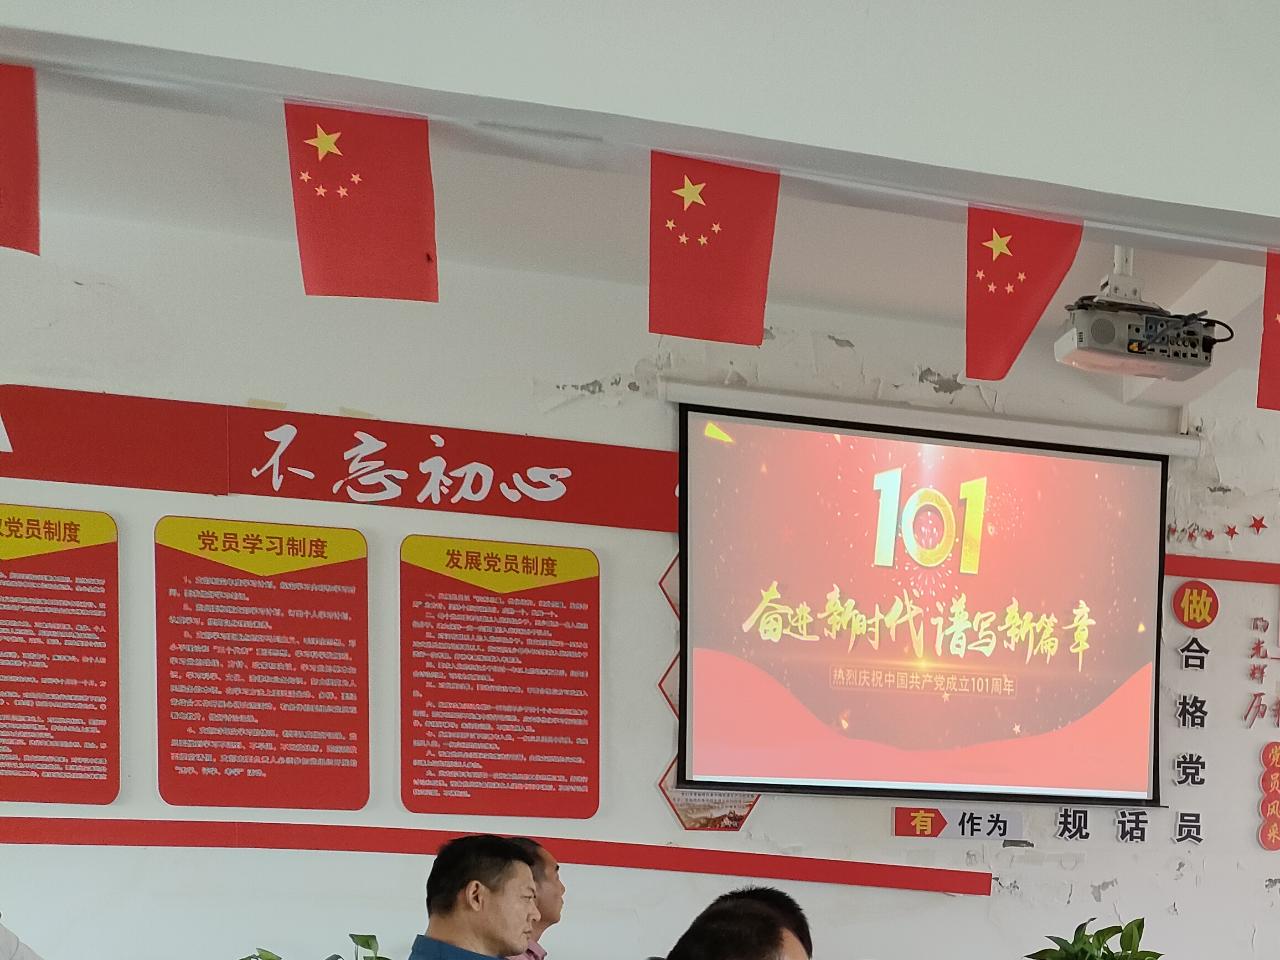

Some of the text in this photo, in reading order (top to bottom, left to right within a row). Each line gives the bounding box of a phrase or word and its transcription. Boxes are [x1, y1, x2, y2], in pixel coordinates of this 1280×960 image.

[251, 424, 572, 504] 不忘初心
[873, 467, 987, 575] 101
[197, 530, 328, 559] 党员学习制度
[445, 548, 558, 578] 发展党员制度
[832, 668, 1015, 696] 热烈庆祝中国共产党成立101周年
[1058, 808, 1090, 840] 规
[1117, 810, 1149, 843] 话
